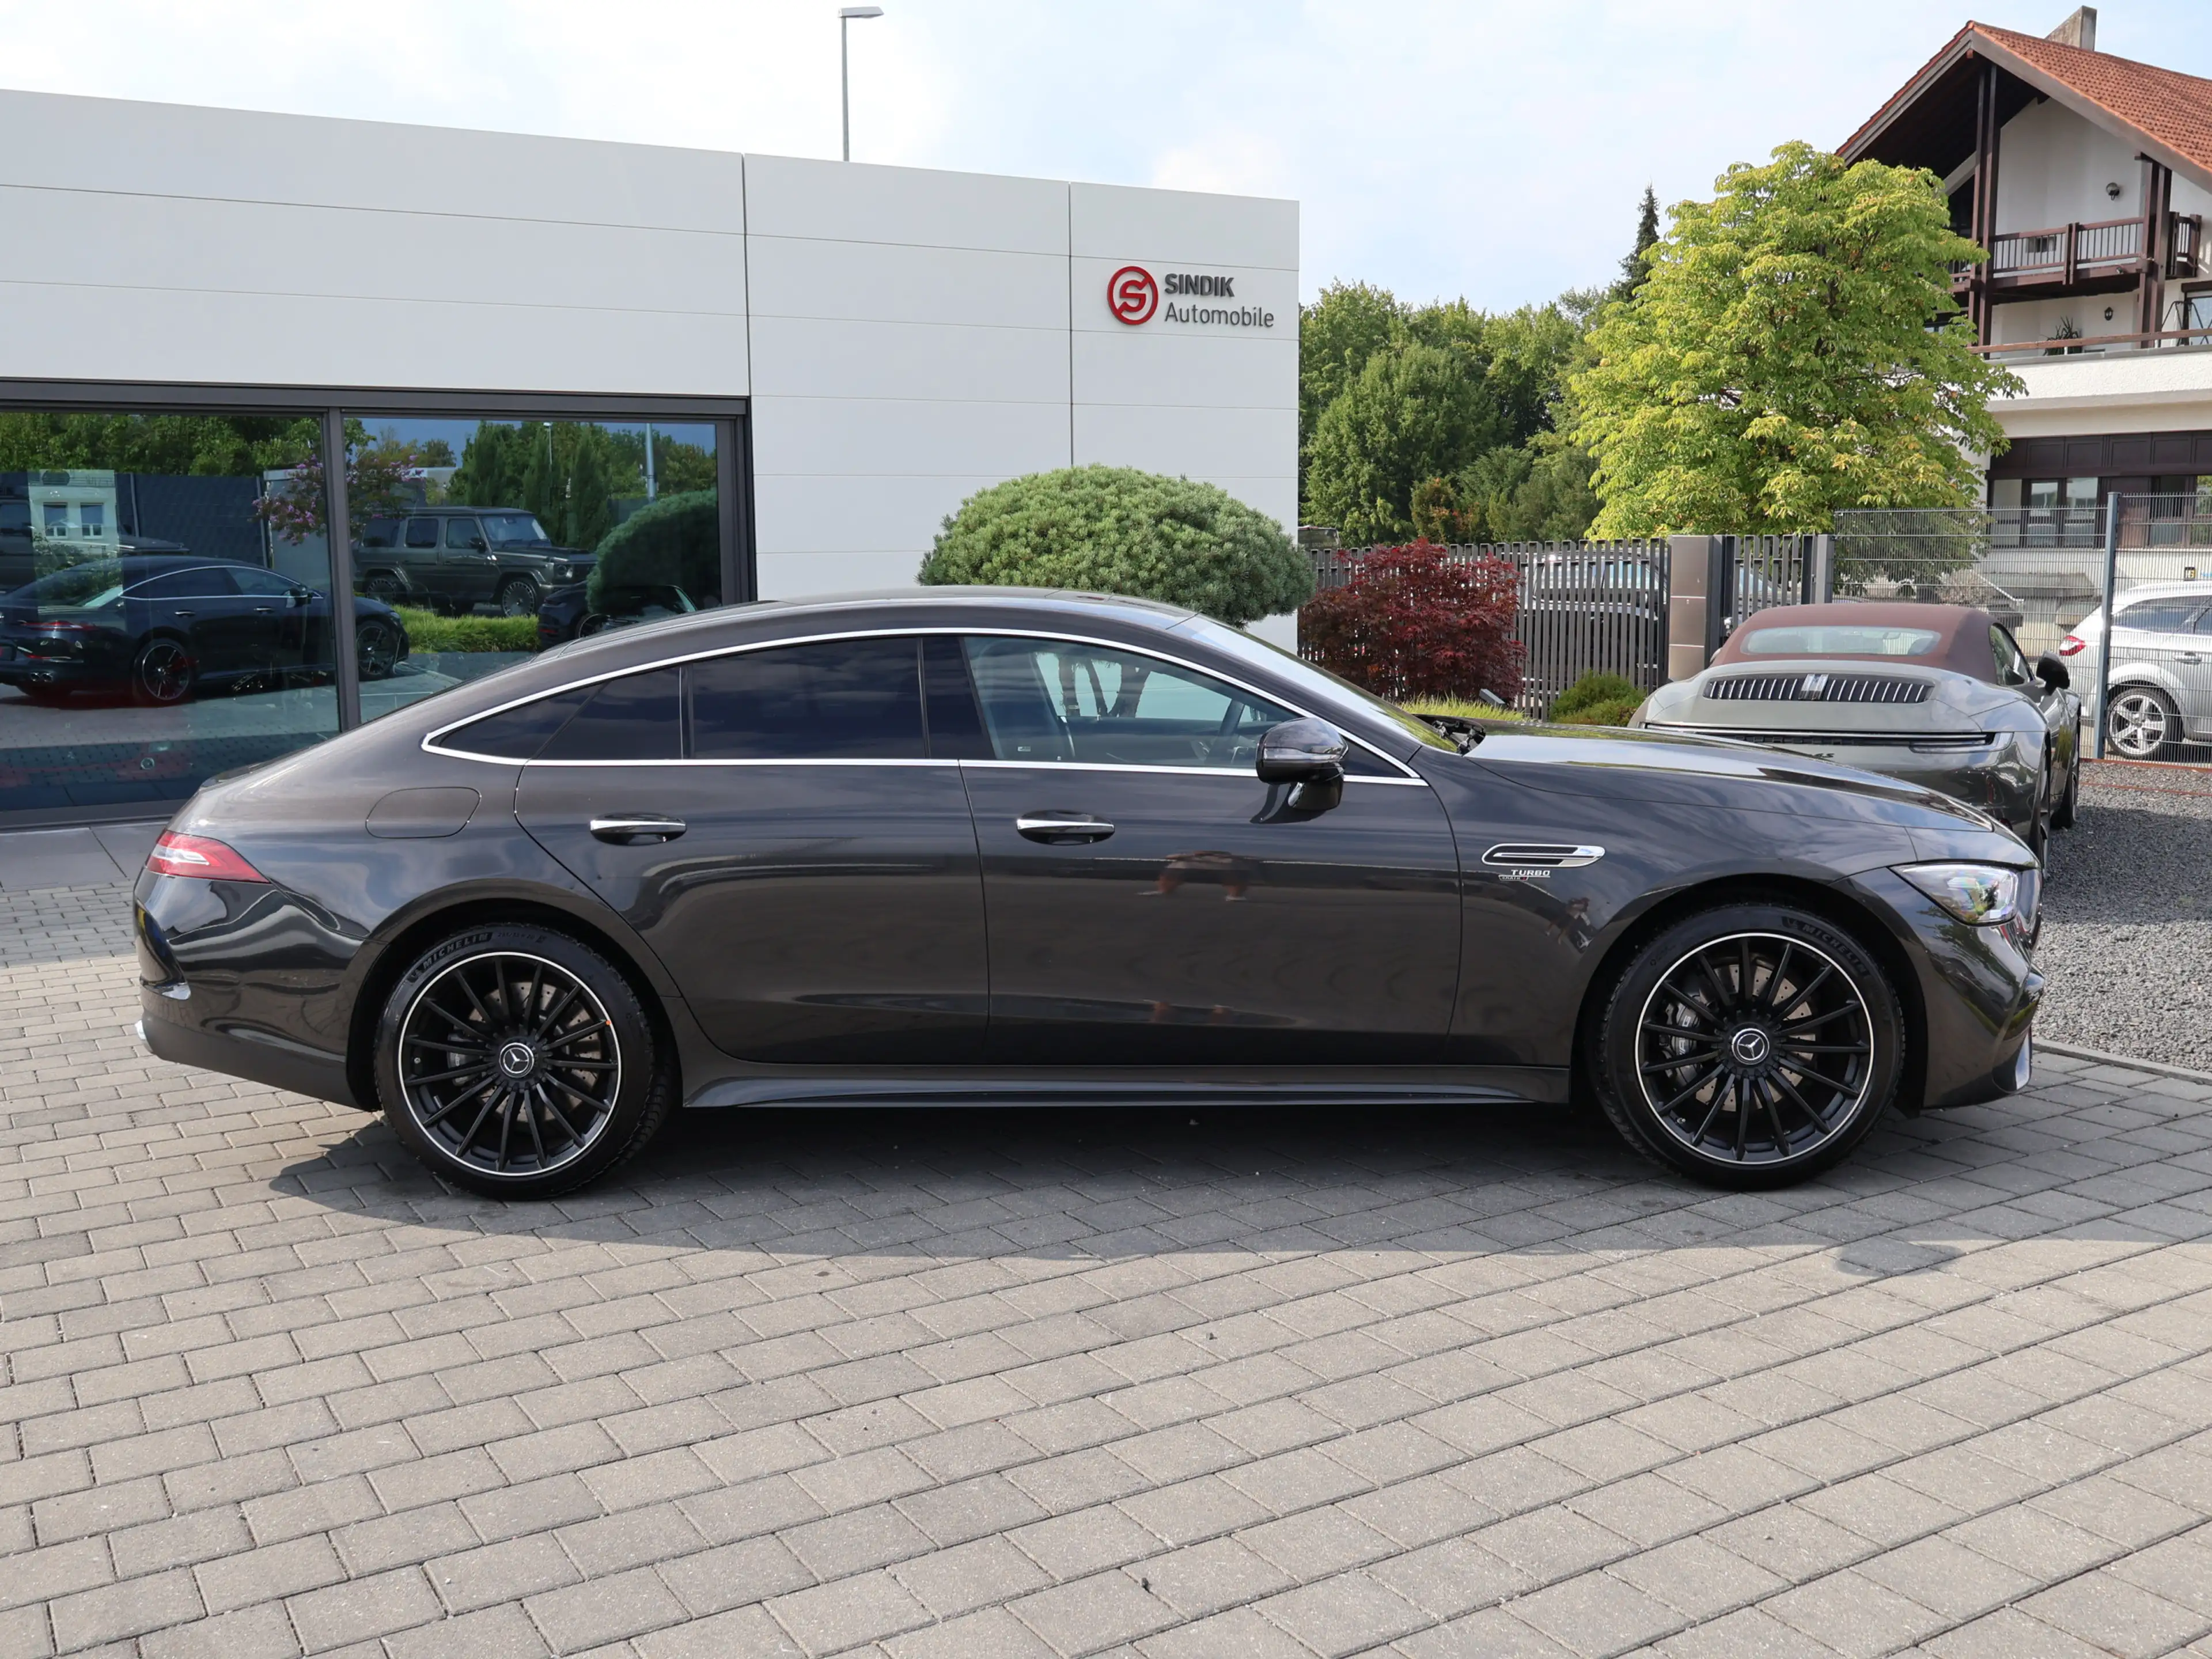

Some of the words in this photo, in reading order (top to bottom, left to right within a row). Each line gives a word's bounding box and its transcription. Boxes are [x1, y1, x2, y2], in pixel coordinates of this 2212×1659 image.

[1164, 273, 1234, 297] SINDIK
[1164, 302, 1274, 328] Automobile
[423, 933, 489, 969] MICHELIN
[1802, 924, 1868, 974] MICHELIN
